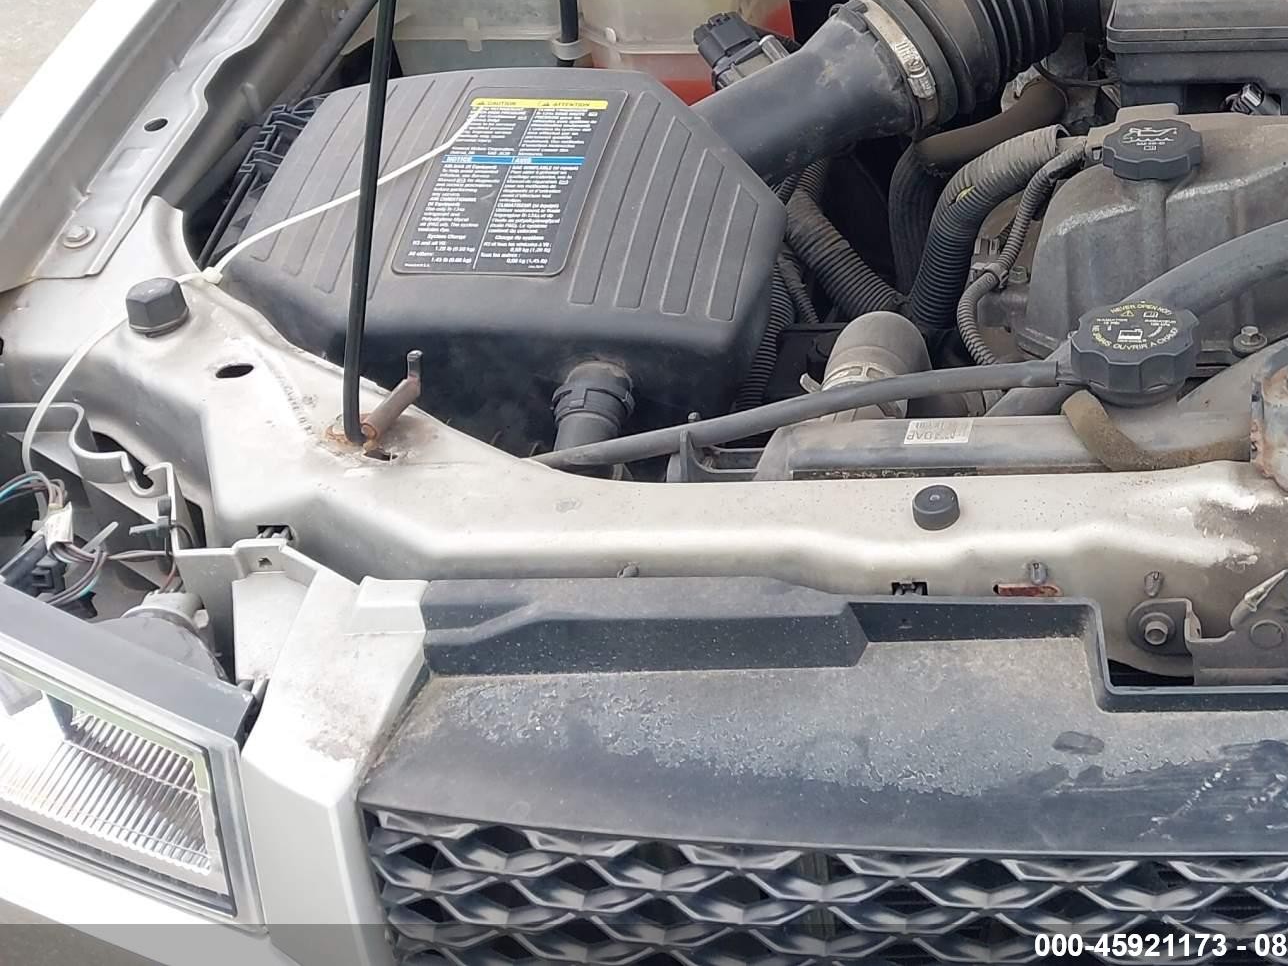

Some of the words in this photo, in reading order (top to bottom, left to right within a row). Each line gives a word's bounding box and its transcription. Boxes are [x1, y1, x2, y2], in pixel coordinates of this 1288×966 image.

[1110, 304, 1136, 314] NEVER
[1137, 303, 1157, 311] OPEN
[1113, 342, 1148, 351] OUVRIR
